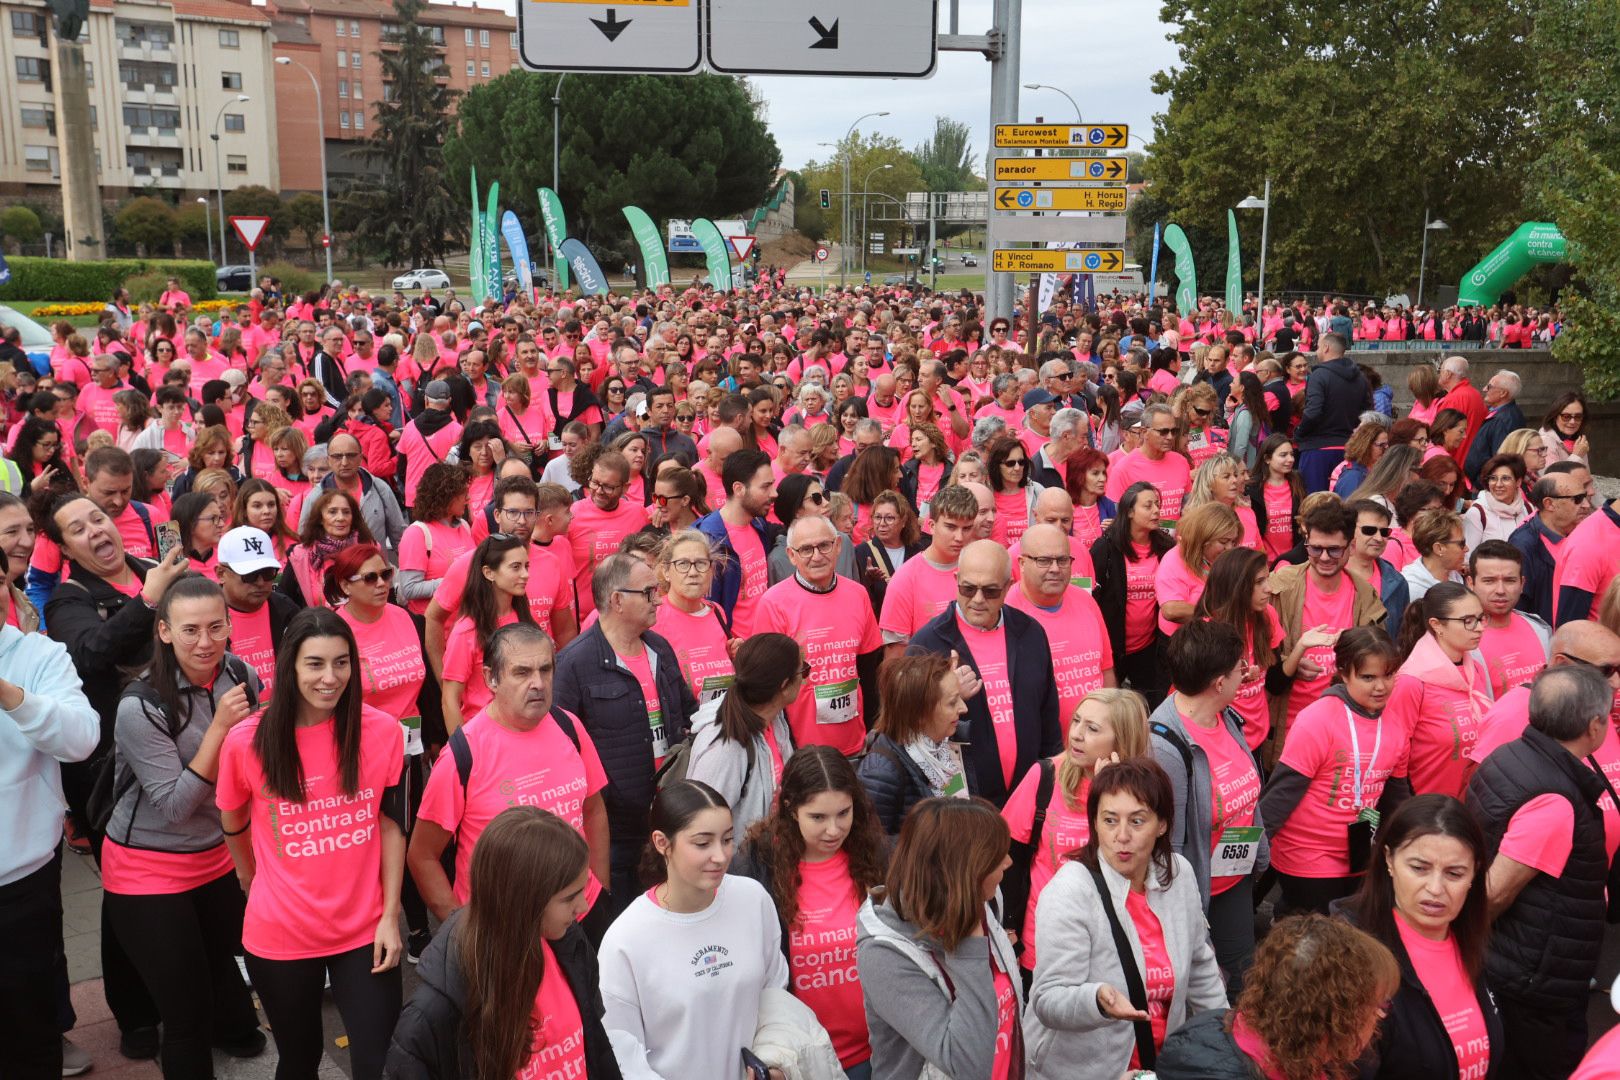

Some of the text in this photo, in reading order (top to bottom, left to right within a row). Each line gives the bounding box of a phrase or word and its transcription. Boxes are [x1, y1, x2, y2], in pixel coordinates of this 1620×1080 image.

[1012, 128, 1057, 137] Eurowest
[998, 165, 1036, 175] parador
[1097, 191, 1124, 199] Horus
[1098, 199, 1123, 209] Regio
[1529, 230, 1543, 239] En
[1527, 240, 1553, 248] contra
[1008, 253, 1033, 261] Vincci
[1007, 261, 1017, 269] P.
[1019, 261, 1054, 269] Romano
[243, 537, 264, 555] NY
[595, 541, 608, 550] En
[807, 642, 821, 654] En
[367, 644, 419, 667] En marcha
[809, 651, 851, 668] contra
[1062, 649, 1101, 666] marcha
[373, 660, 414, 677] contra
[690, 661, 705, 673] En
[829, 694, 852, 710] 4175
[1457, 715, 1471, 727] En
[1218, 782, 1231, 796] En
[517, 793, 540, 807] En
[278, 801, 303, 816] En
[280, 802, 374, 837] contra el
[284, 823, 376, 858] cáncer
[1056, 832, 1076, 847] En
[1221, 843, 1250, 860] 6536
[791, 930, 815, 947] En
[691, 944, 729, 966] SACRAMENTO
